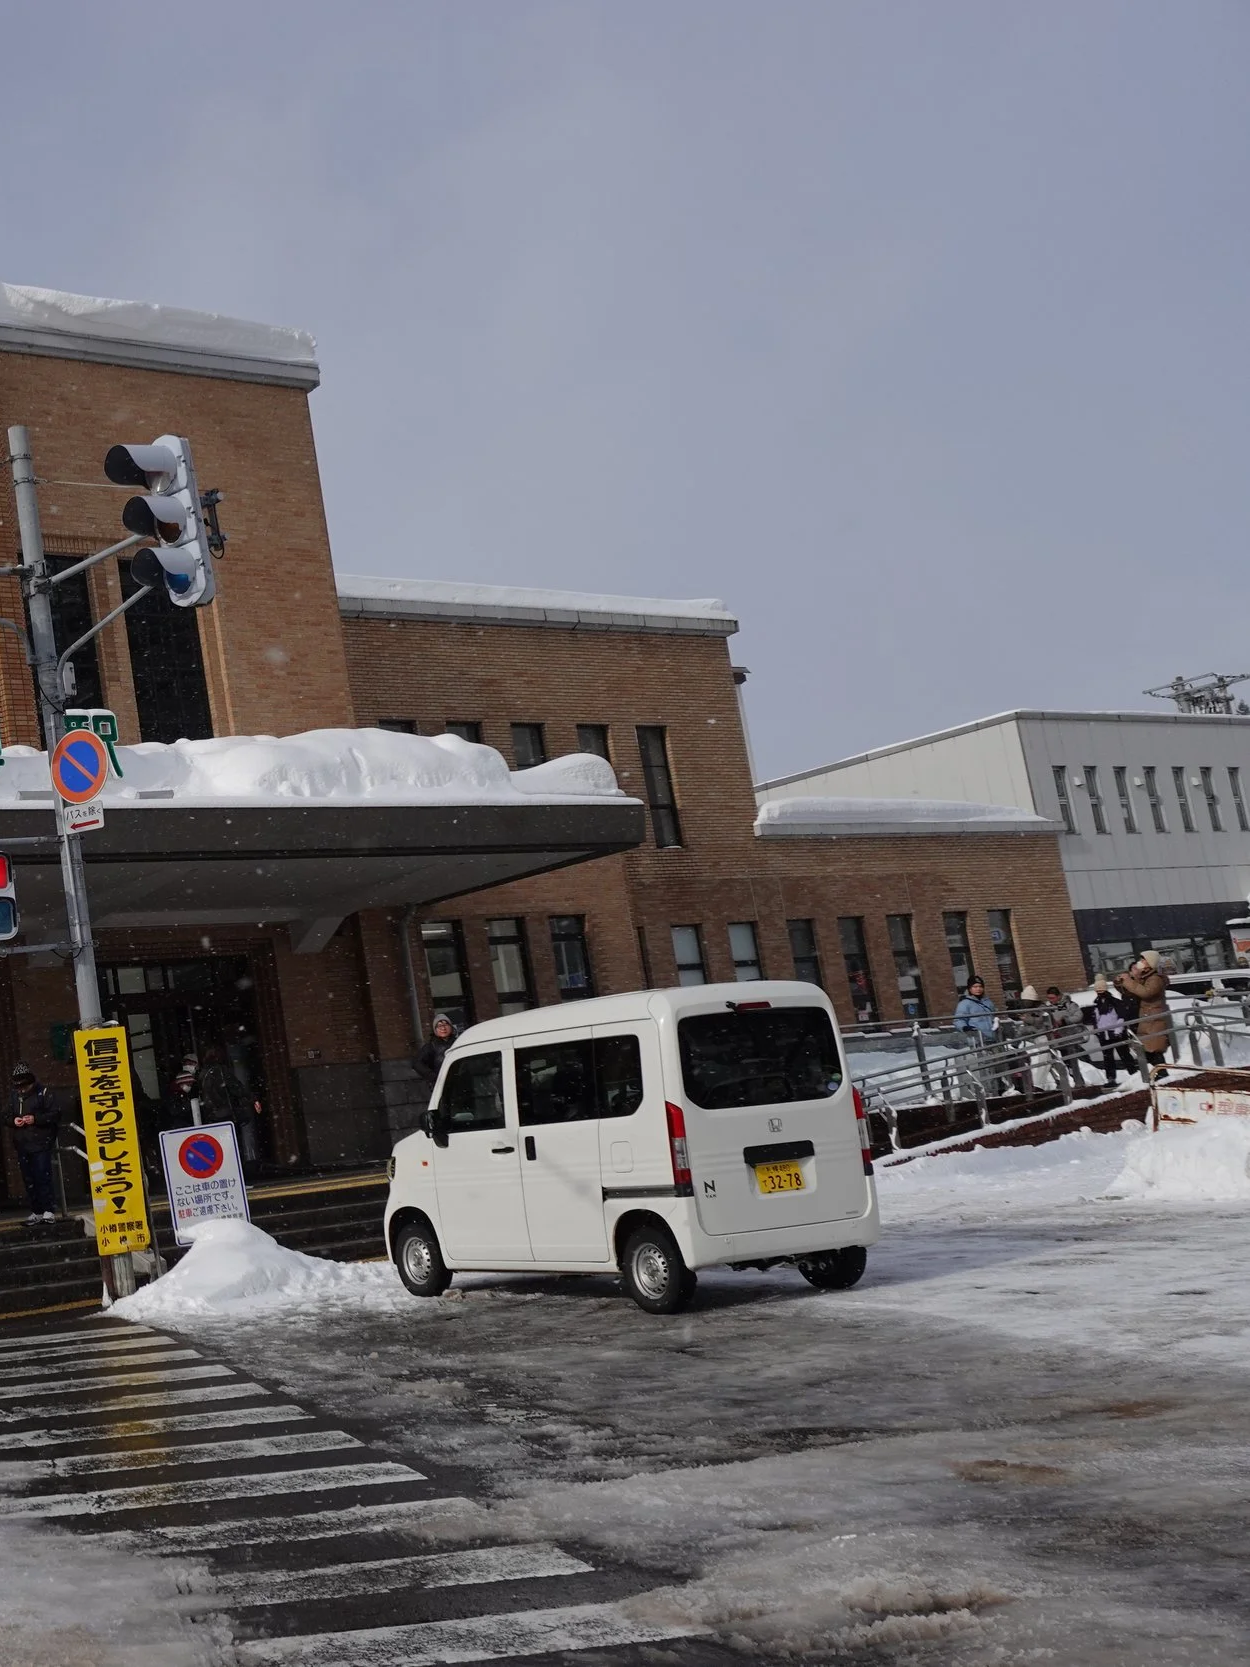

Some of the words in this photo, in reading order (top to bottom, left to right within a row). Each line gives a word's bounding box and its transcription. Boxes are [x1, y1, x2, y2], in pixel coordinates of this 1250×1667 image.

[66, 805, 101, 820] バスを除く
[175, 1178, 236, 1197] ここは車の置け
[703, 1179, 716, 1193] N
[768, 1172, 802, 1190] 32-78
